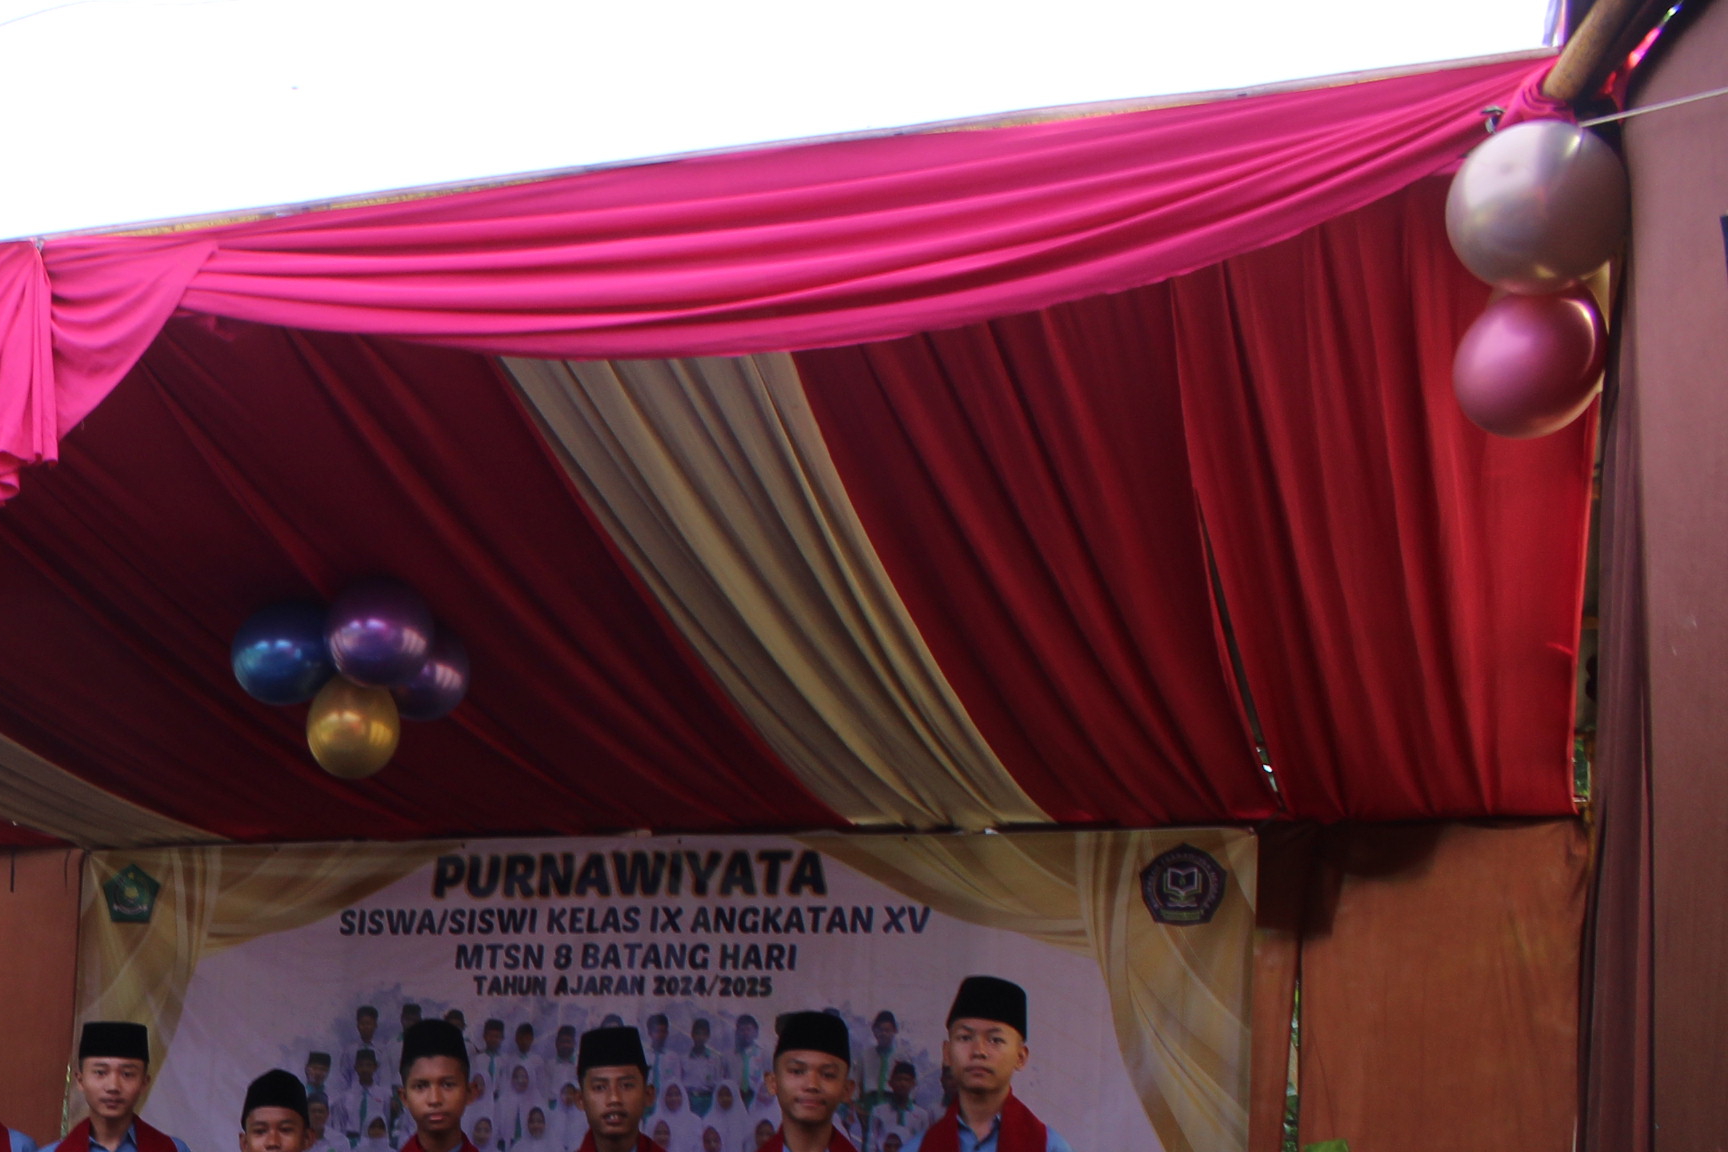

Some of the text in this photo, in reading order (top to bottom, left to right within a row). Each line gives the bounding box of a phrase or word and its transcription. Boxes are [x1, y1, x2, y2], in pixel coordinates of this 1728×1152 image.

[433, 850, 828, 900] PURNAWIYATA
[339, 906, 931, 936] SISWA/SISWI KELAS IX ANGKATAN XV
[455, 943, 797, 971] MTSN 8 BATANG HARI
[473, 975, 772, 997] TAHUN AJARAN 2024/2025
